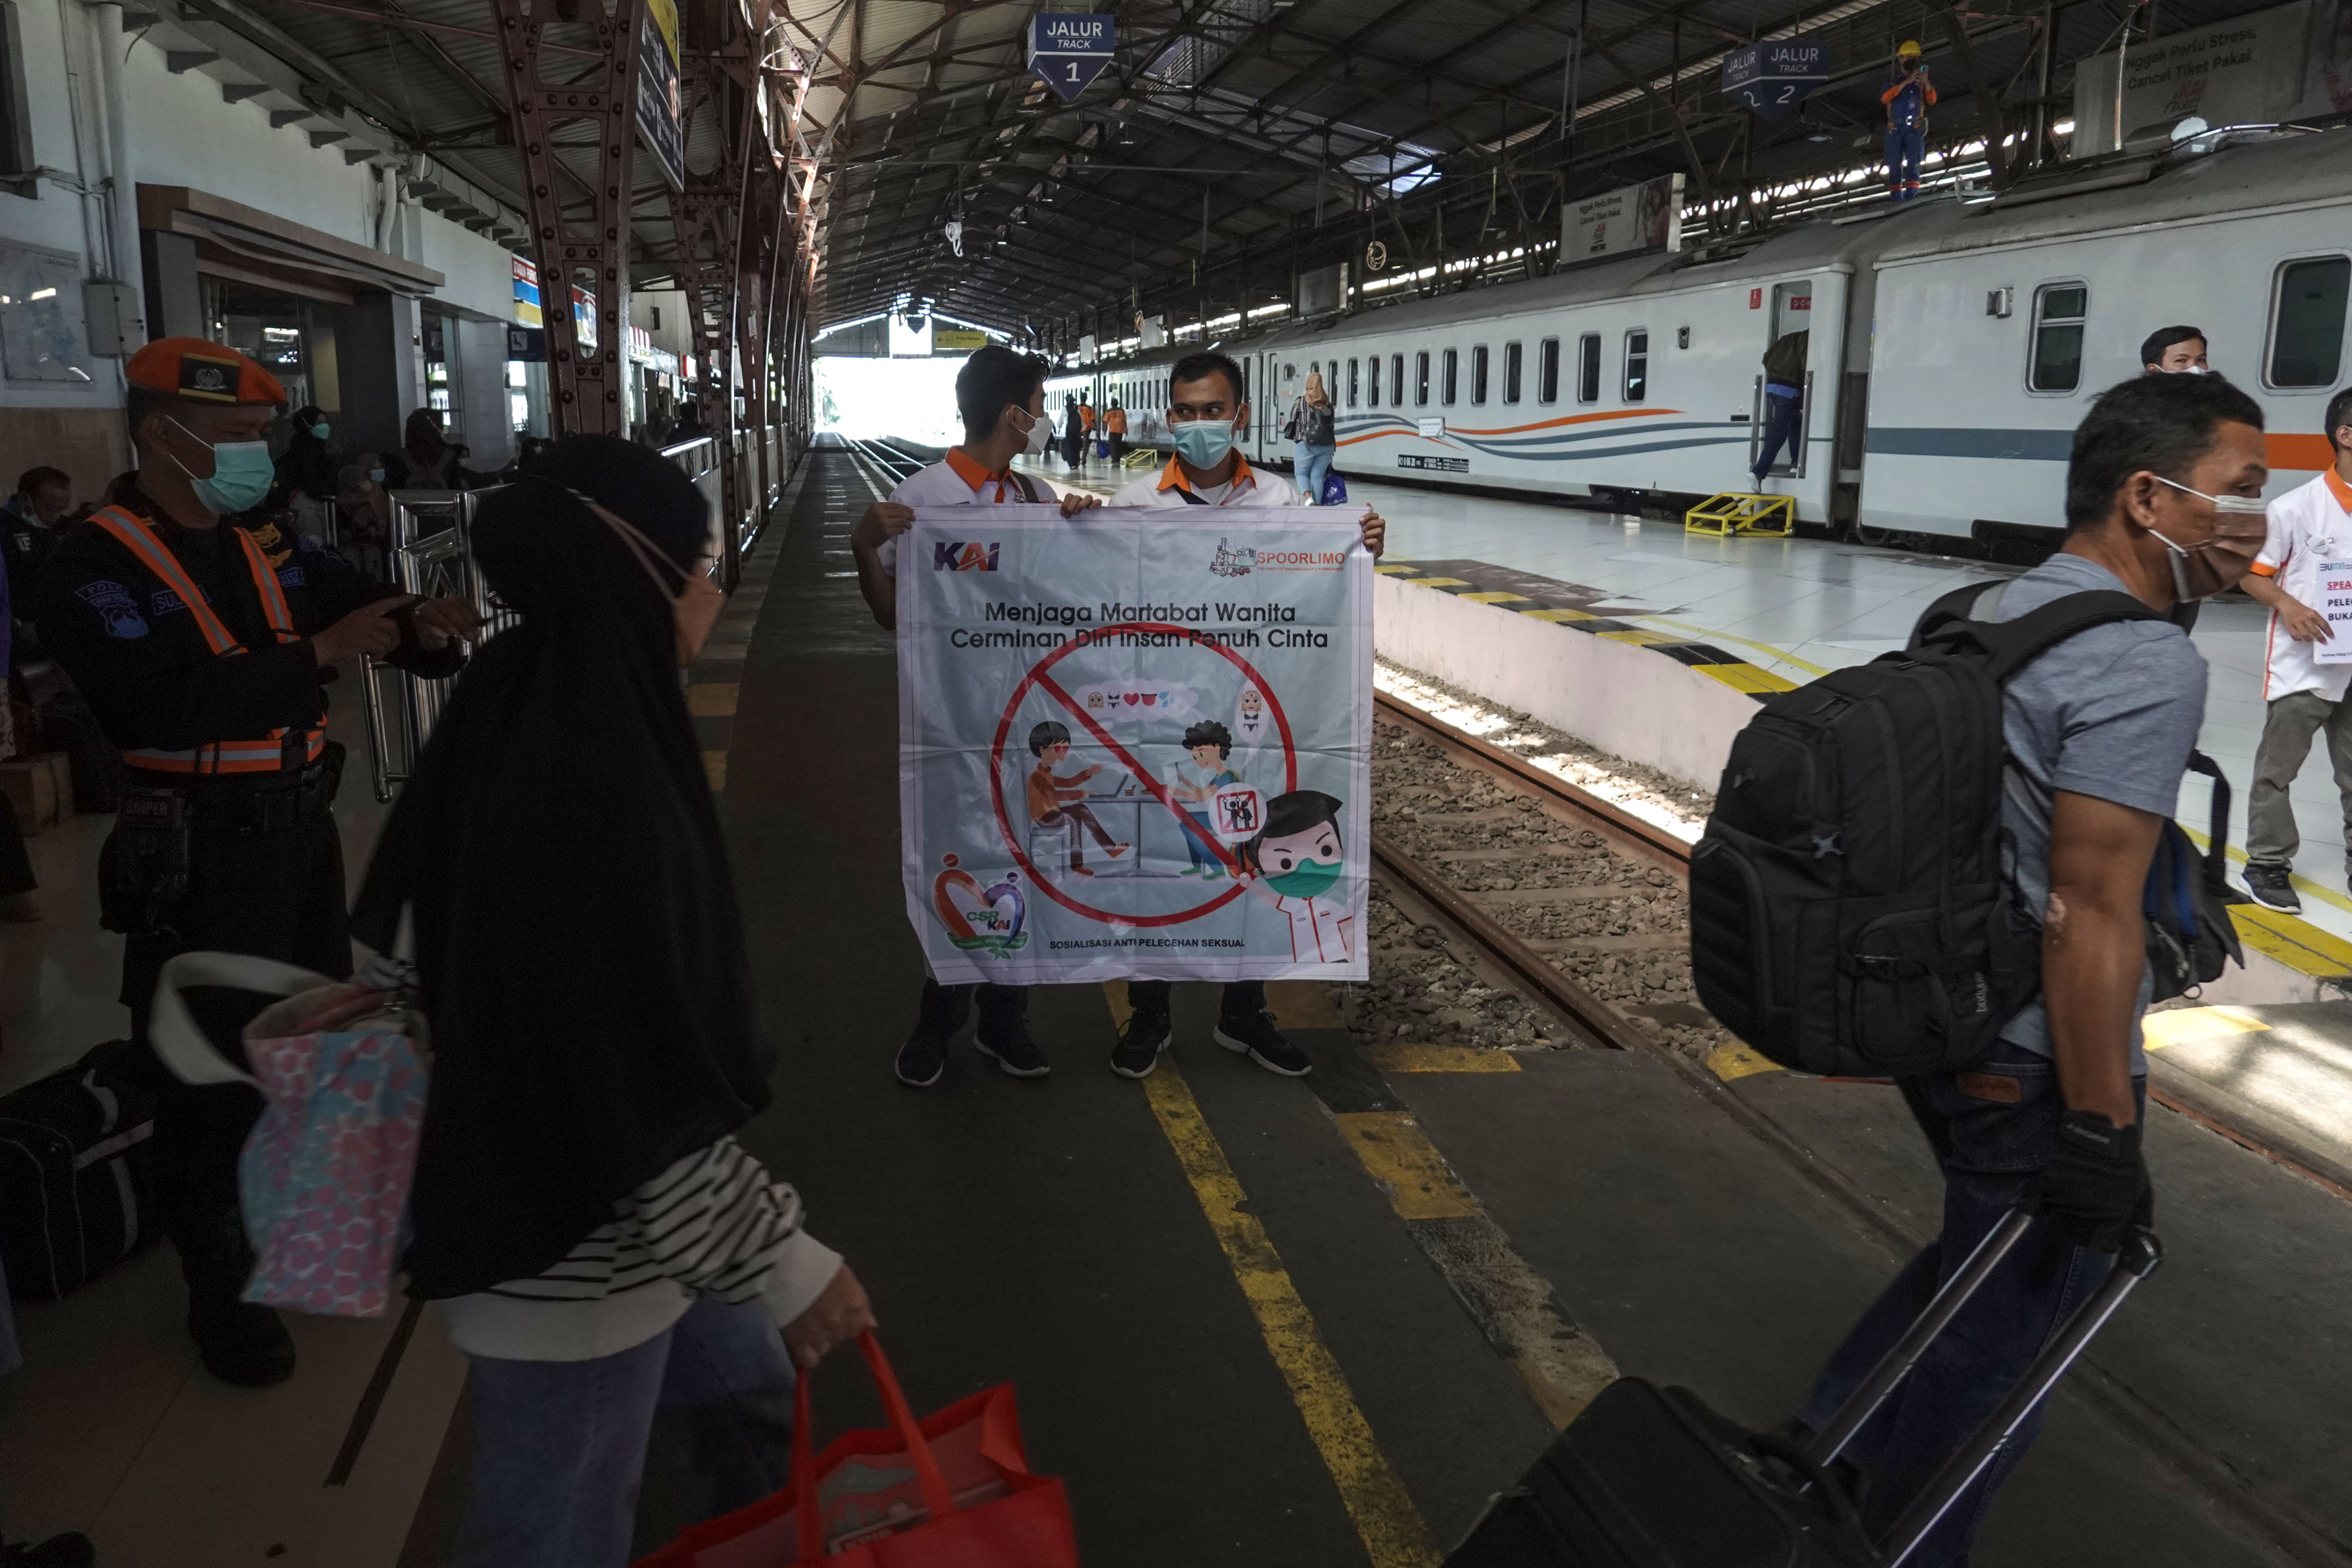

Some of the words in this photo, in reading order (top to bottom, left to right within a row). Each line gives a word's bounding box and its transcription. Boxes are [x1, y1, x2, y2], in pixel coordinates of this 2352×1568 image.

[1047, 21, 1102, 37] JALUR
[1057, 39, 1091, 49] TRACK
[2170, 38, 2206, 58] Perlu
[1728, 51, 1756, 73] JALUR
[1770, 48, 1819, 61] JALUR
[1065, 62, 1081, 82] 1
[1779, 64, 1809, 73] TRACK
[2127, 66, 2172, 89] Cancel
[2176, 61, 2209, 78] Tiket
[2212, 48, 2251, 70] Pakai
[1743, 91, 1760, 107] 2
[1776, 85, 1795, 103] 2
[934, 542, 1000, 571] KAI
[1257, 552, 1345, 564] SPOORLIMO
[2328, 598, 2352, 607] PELE
[985, 602, 1091, 626] Menjaga
[1101, 602, 1208, 621] Martabat
[1215, 602, 1295, 622] Wanita
[951, 628, 1067, 648] Cerminan
[1075, 628, 1111, 647] Diri
[1189, 628, 1259, 647] Penuh
[1268, 628, 1327, 648] Cinta
[966, 911, 1000, 921] CSR
[987, 920, 1010, 931] KAI
[1050, 939, 1111, 950] SOSIALISASI
[1114, 938, 1137, 947] ANTI
[1139, 938, 1198, 948] PELECEHAN
[1201, 938, 1245, 948] SEKSUAL
